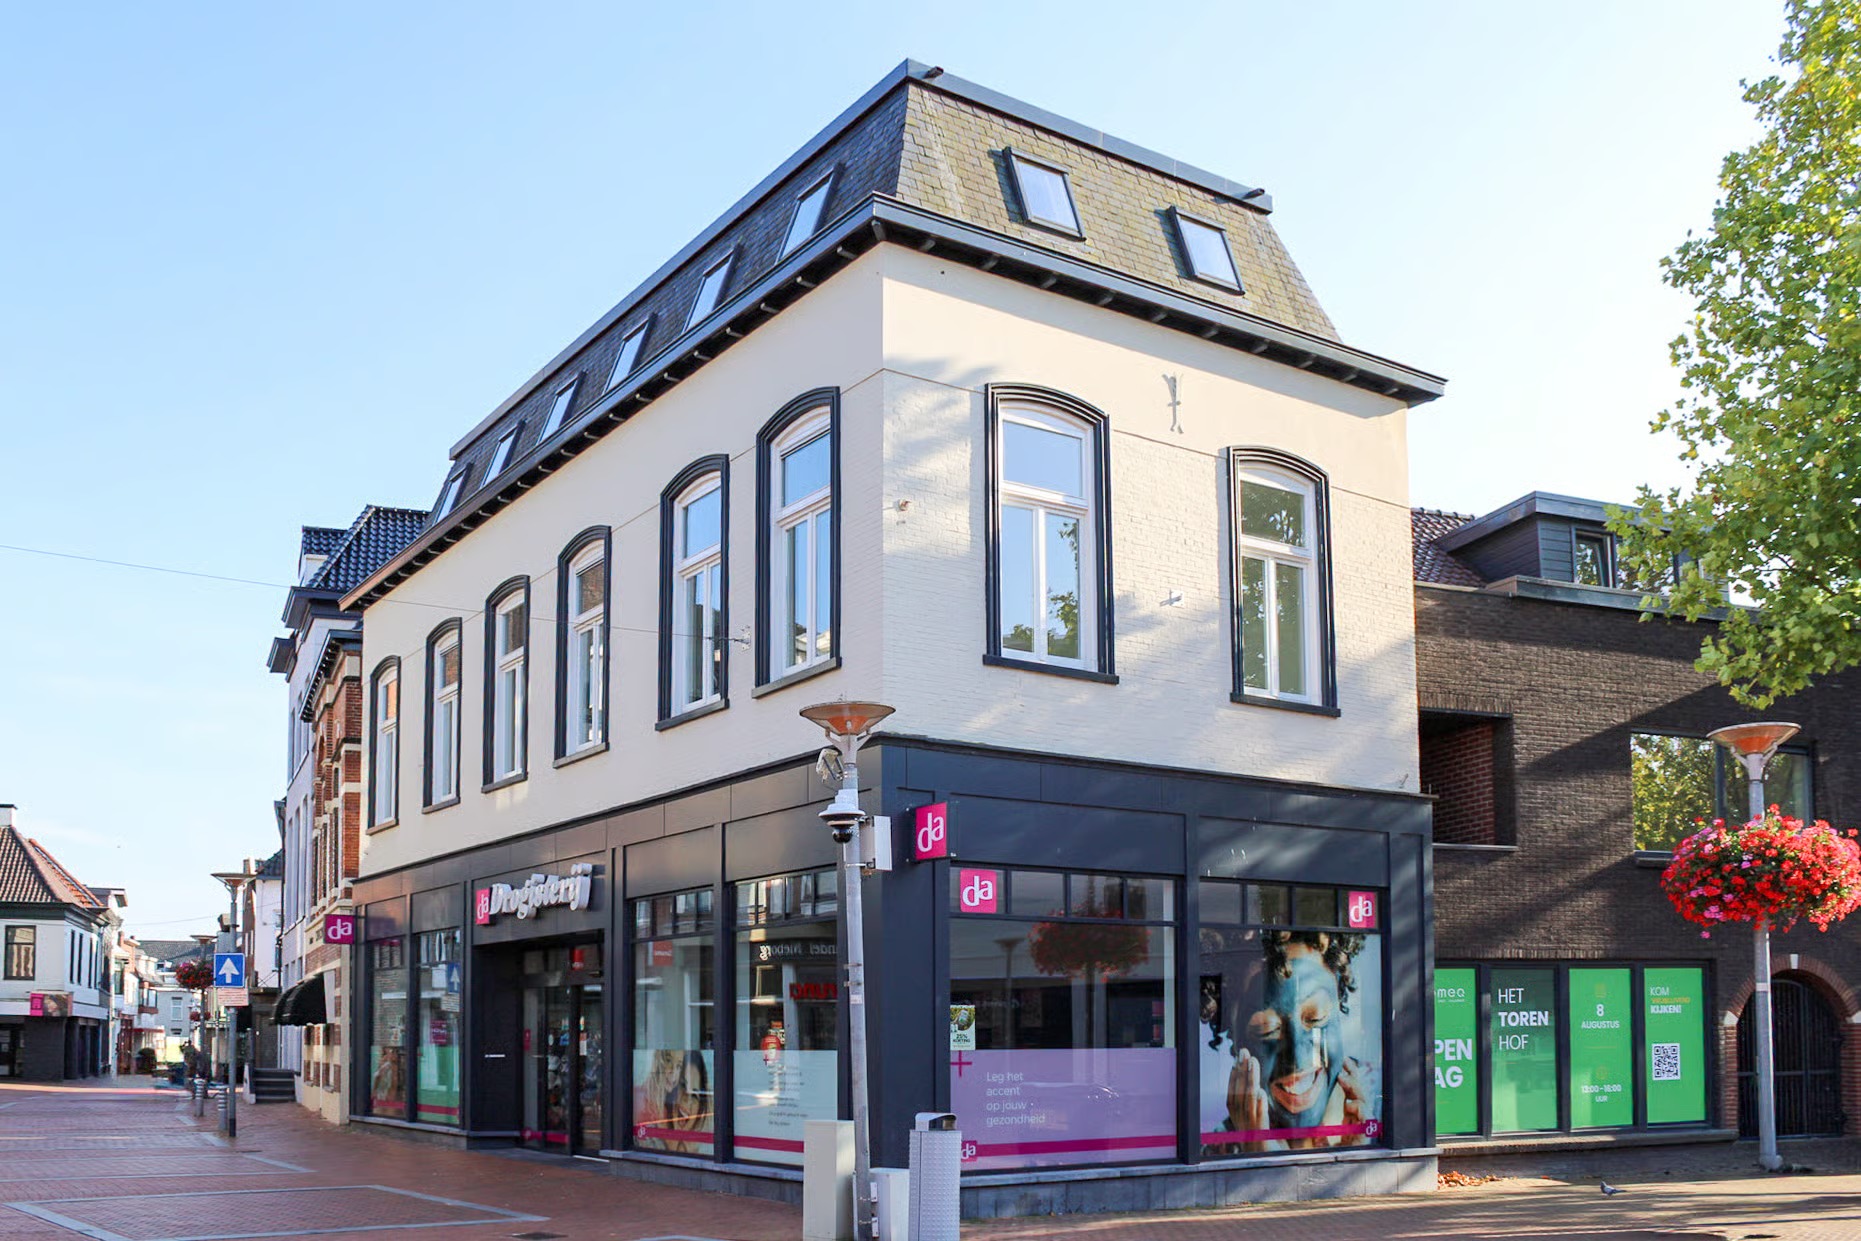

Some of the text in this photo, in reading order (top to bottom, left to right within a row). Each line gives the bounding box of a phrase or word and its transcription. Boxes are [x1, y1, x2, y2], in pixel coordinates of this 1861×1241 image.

[917, 812, 945, 853] da
[476, 863, 593, 920] da Drogisterij
[962, 875, 994, 907] da
[1350, 896, 1373, 923] da
[327, 918, 353, 940] da
[1498, 988, 1525, 1004] HET
[1650, 986, 1670, 996] KOM
[1596, 1003, 1605, 1017] 8
[1650, 1004, 1682, 1014] KIJKEN!
[1498, 1010, 1549, 1027] TOREN
[1581, 1020, 1620, 1029] AUGUSTUS
[1434, 1038, 1473, 1061] PEN
[1499, 1034, 1529, 1051] HOF
[986, 1071, 1024, 1083] Leg het
[1434, 1065, 1464, 1089] AG
[986, 1085, 1021, 1096] accent
[986, 1100, 1027, 1112] op jouw
[1595, 1095, 1608, 1103] UUR
[986, 1114, 1046, 1127] gezondheid
[1366, 1121, 1378, 1137] da
[961, 1142, 977, 1160] da
